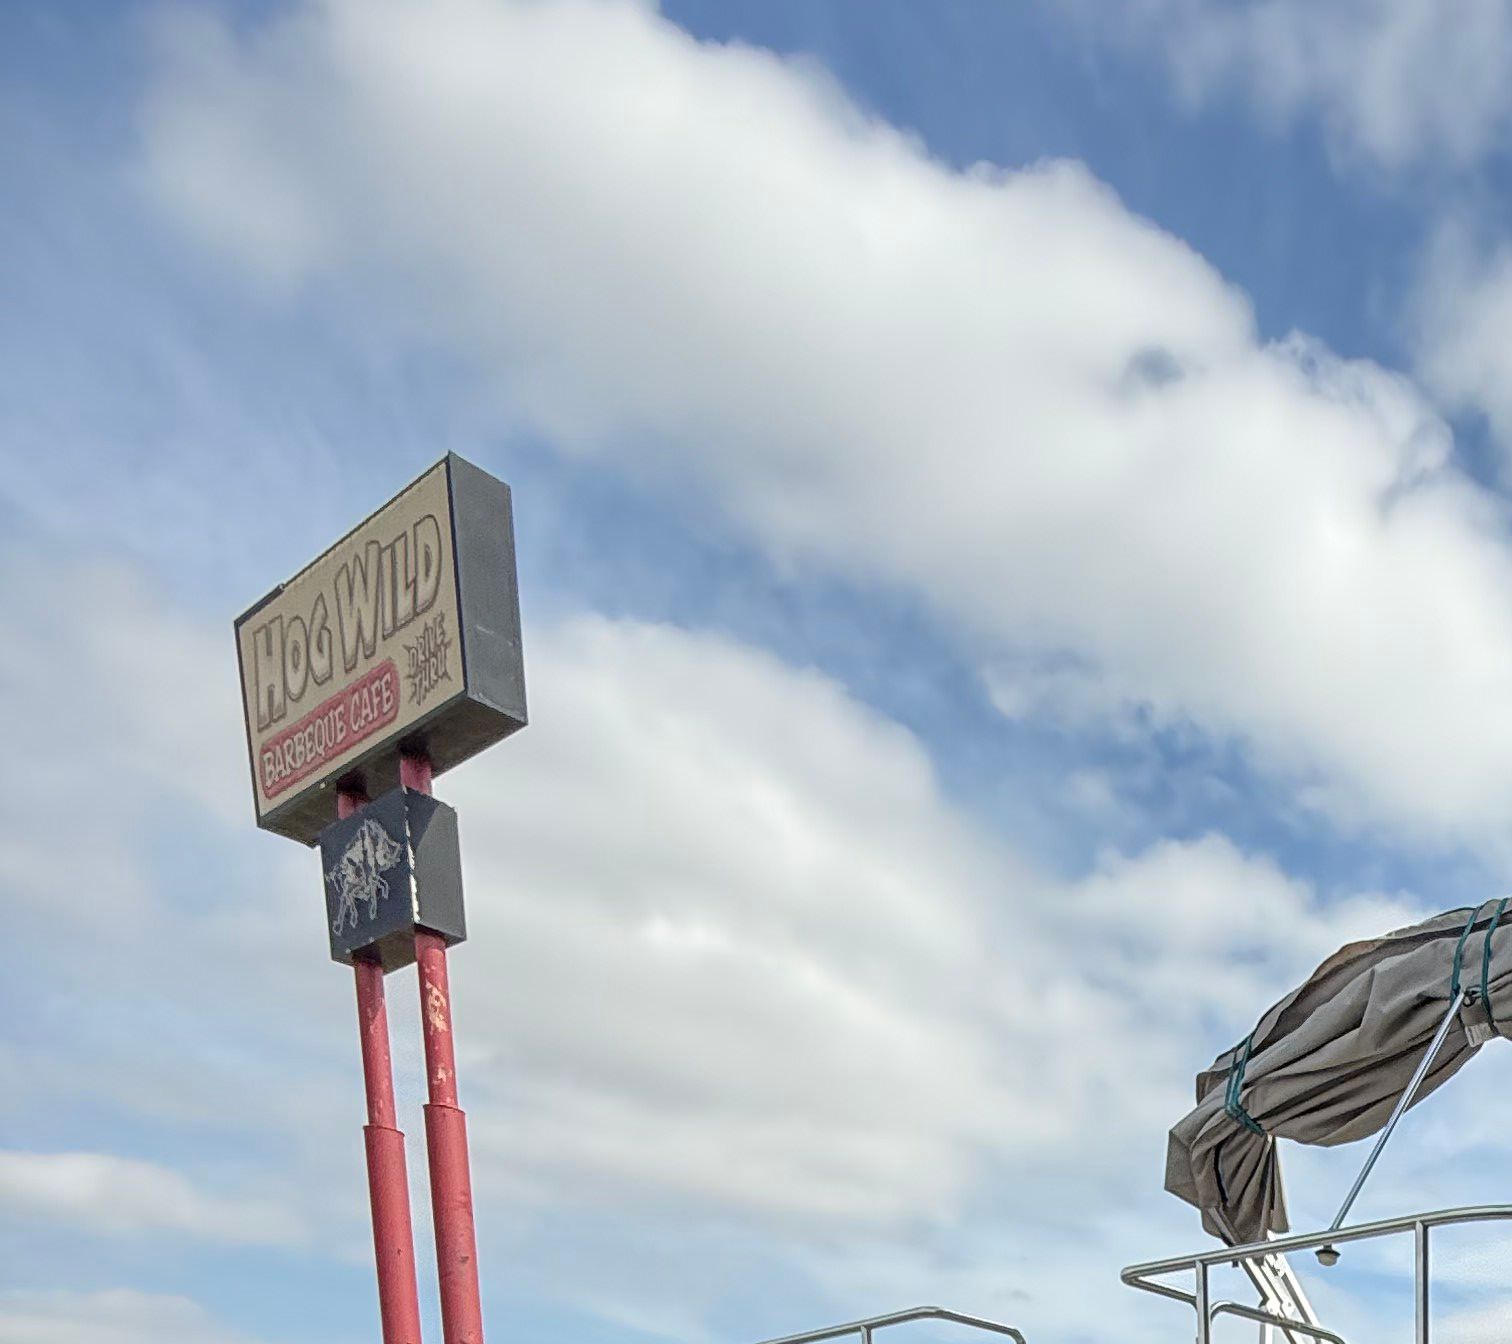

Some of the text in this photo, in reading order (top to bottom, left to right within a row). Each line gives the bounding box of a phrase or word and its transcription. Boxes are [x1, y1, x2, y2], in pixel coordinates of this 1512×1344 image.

[408, 610, 446, 678] DRIVE
[411, 645, 448, 706] THRU
[263, 672, 394, 788] BARBEQUE CAFE
